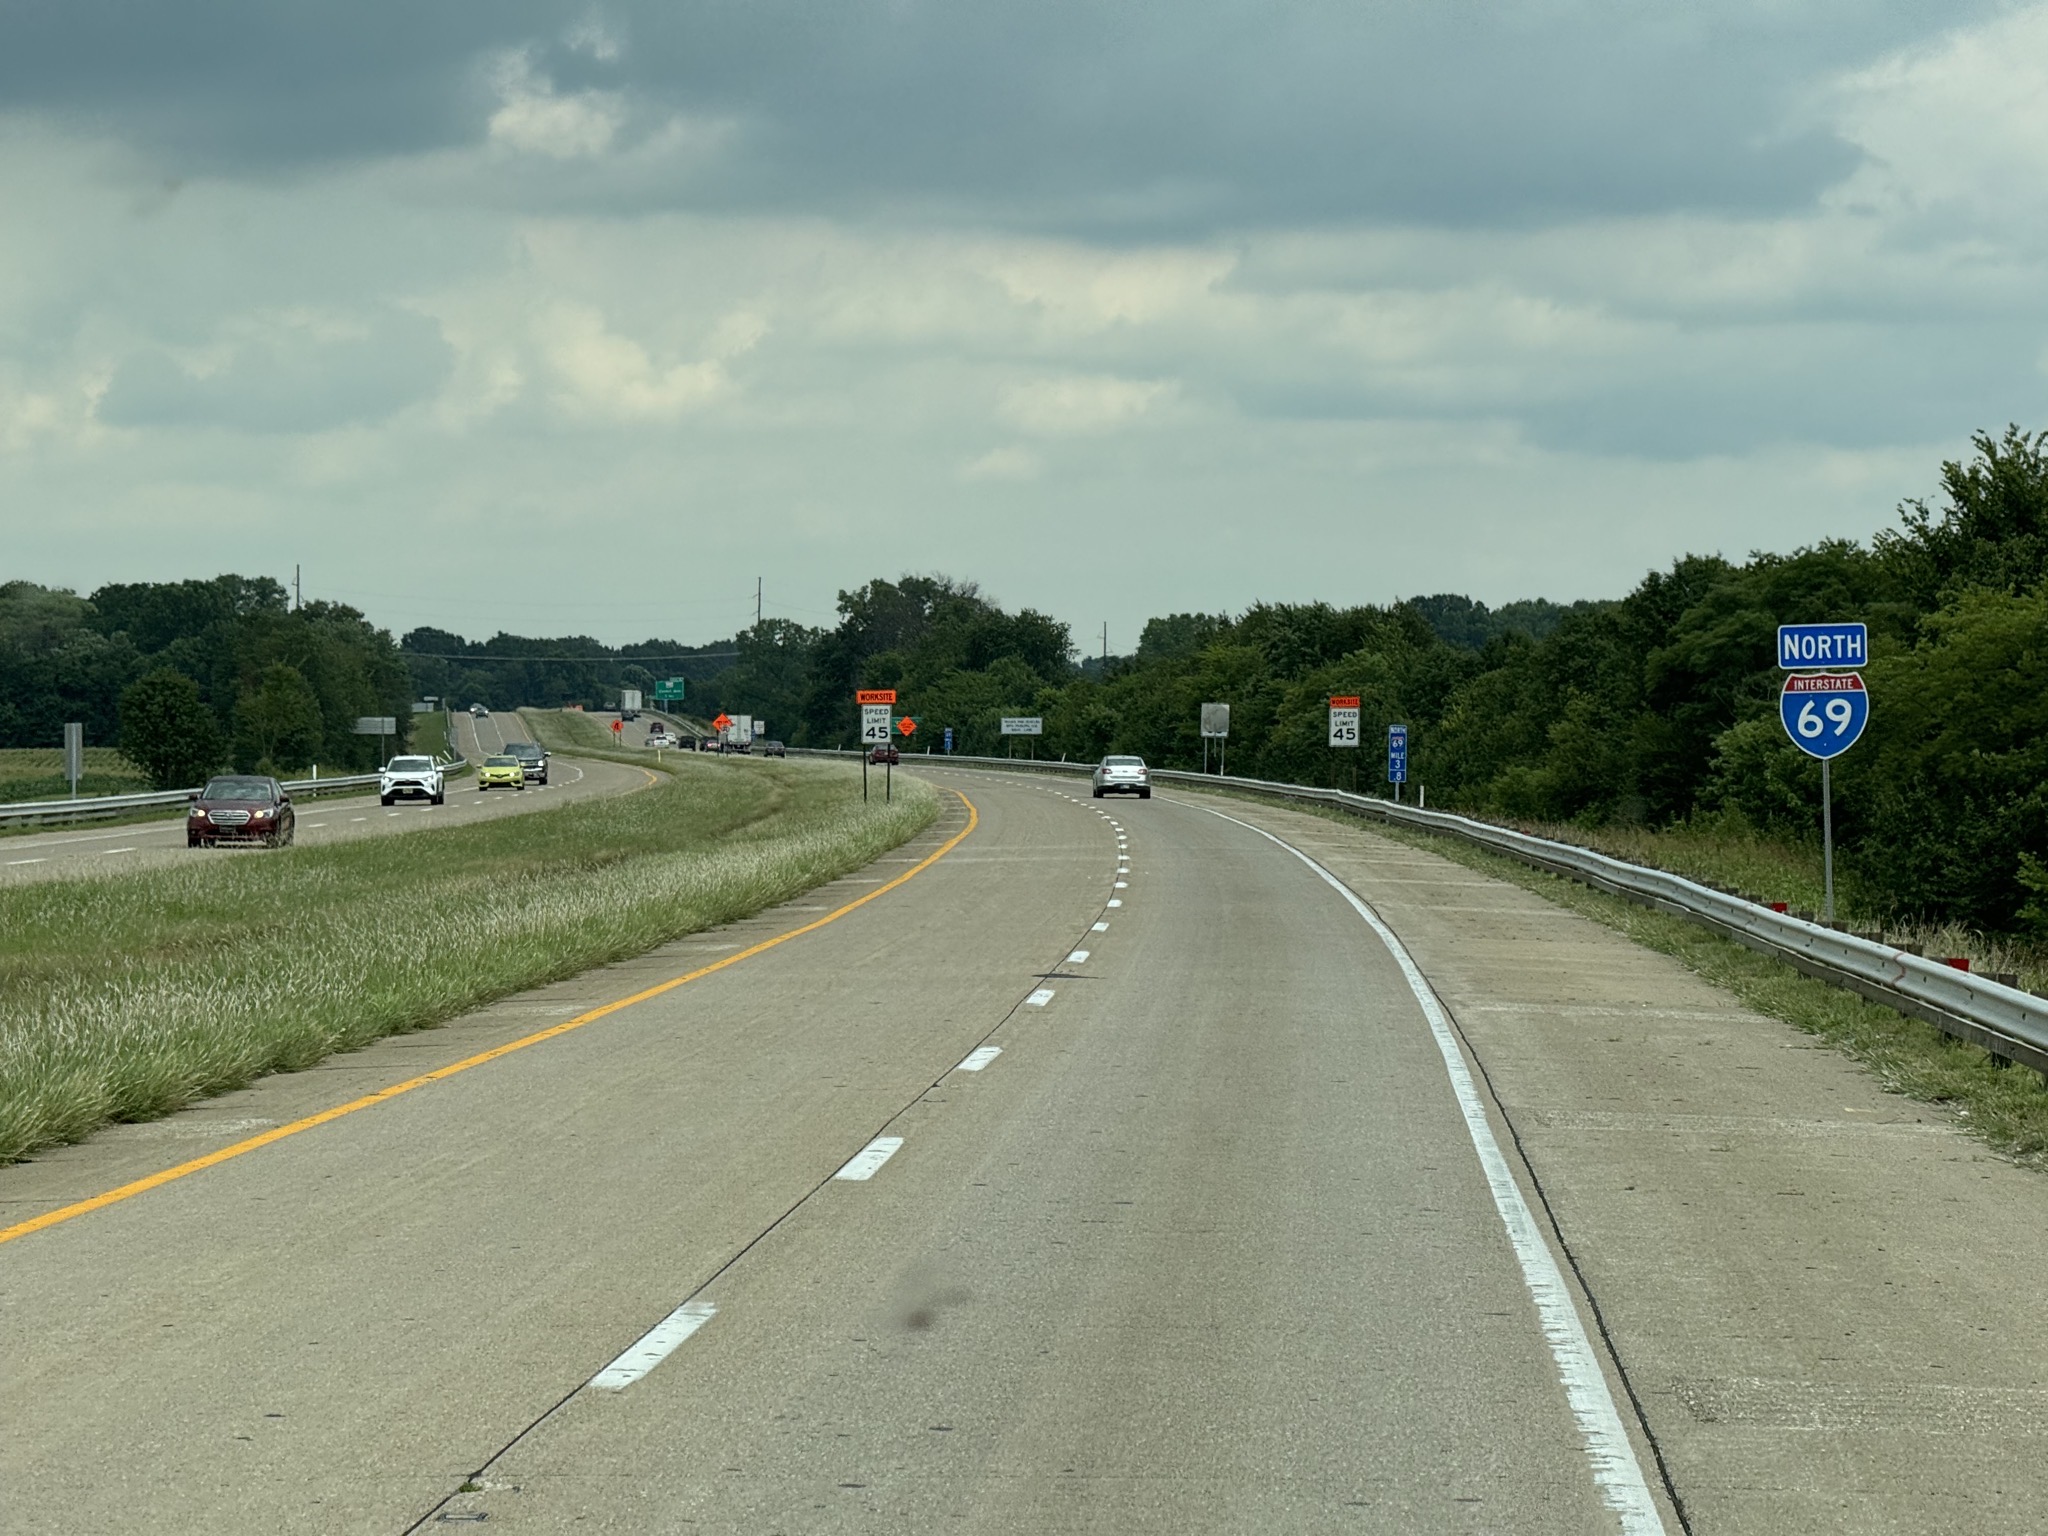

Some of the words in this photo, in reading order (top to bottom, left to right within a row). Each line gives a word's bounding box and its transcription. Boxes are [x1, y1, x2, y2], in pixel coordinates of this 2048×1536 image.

[1784, 634, 1861, 660] NORTH
[1794, 678, 1854, 691] INTERSTATE
[860, 693, 893, 701] WORKSITE
[1797, 698, 1852, 738] 69
[865, 726, 888, 739] 45
[1332, 728, 1356, 740] 45
[1392, 739, 1404, 748] 69
[1394, 760, 1401, 769] 3
